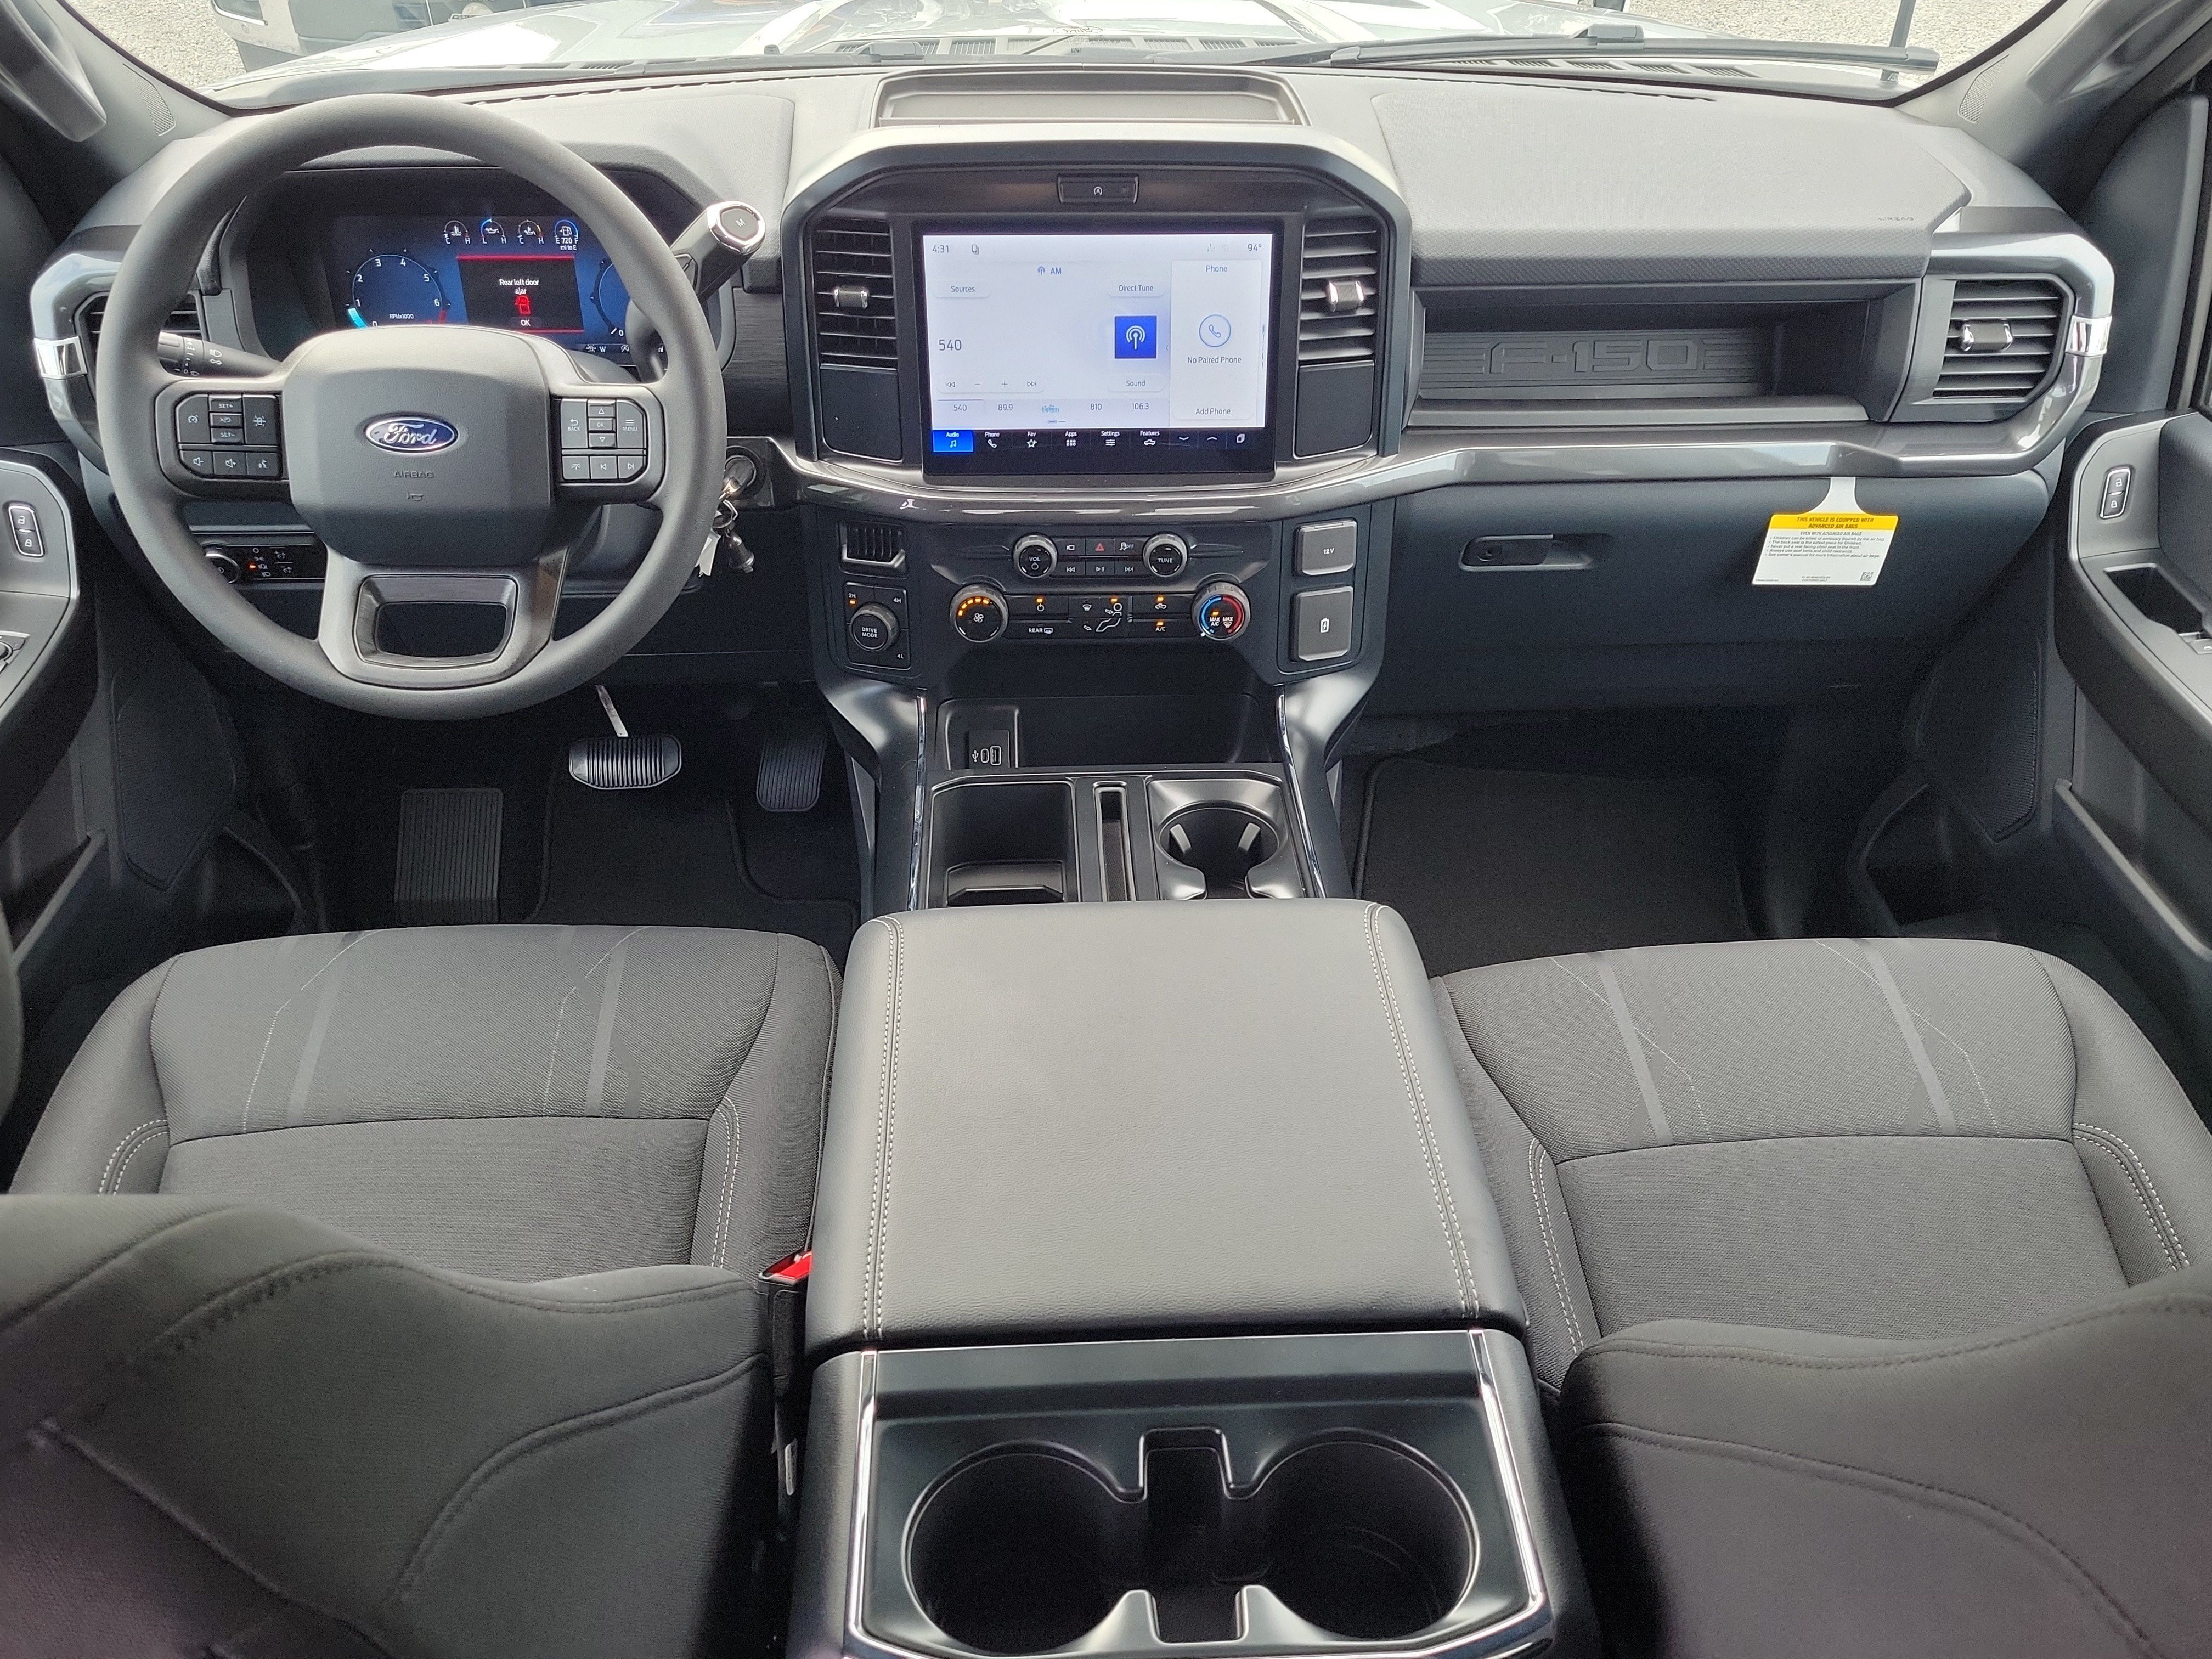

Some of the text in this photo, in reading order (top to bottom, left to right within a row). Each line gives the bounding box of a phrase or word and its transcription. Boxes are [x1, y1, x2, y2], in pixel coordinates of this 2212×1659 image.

[735, 218, 746, 228] M
[933, 245, 950, 253] 4:31
[375, 259, 381, 267] 3
[400, 258, 406, 267] 4
[356, 274, 363, 283] 2
[424, 274, 430, 282] 5
[939, 339, 962, 351] 540
[1489, 338, 1700, 375] F-150
[384, 422, 438, 445] Ford
[394, 470, 435, 479] AIRBAG
